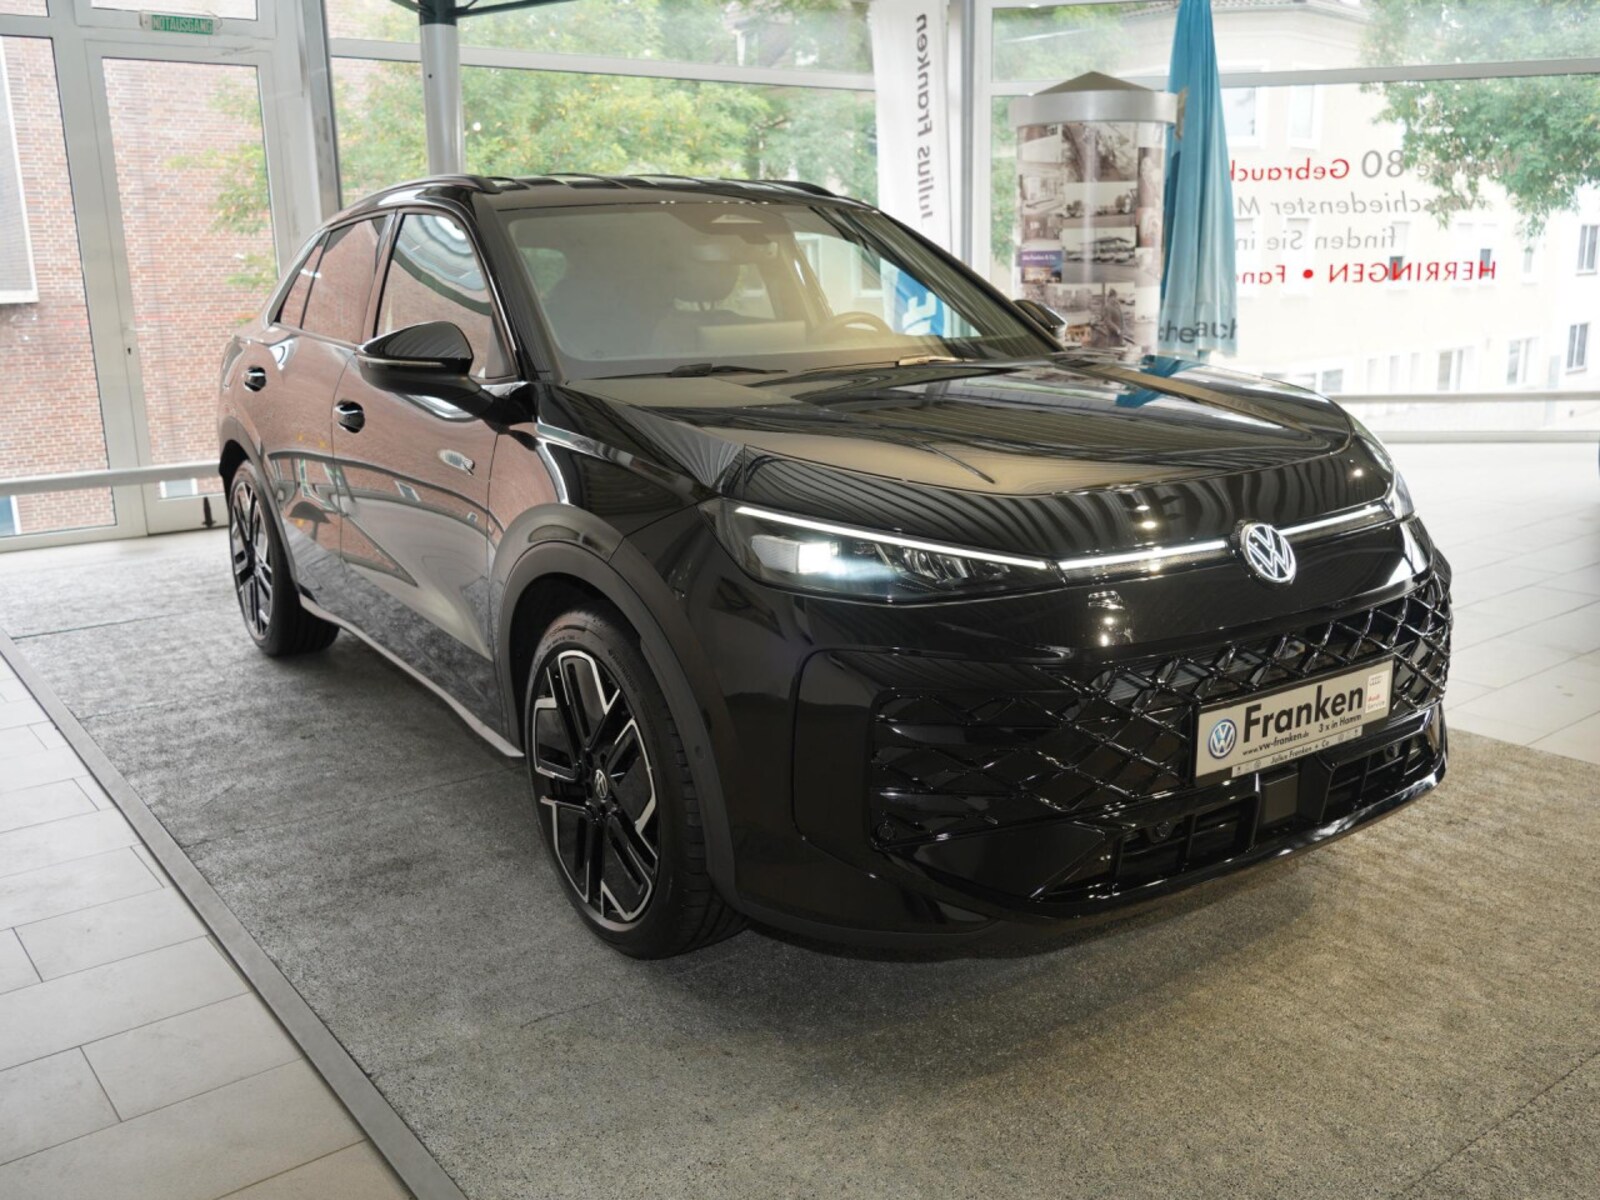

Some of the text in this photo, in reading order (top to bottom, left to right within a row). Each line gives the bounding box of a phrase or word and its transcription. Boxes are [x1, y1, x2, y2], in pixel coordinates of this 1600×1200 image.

[152, 15, 213, 34] NOTAUSGANG
[1243, 685, 1363, 743] Franken
[1242, 730, 1309, 756] www.vw-franken.de
[1318, 723, 1324, 733] 3
[1331, 720, 1338, 730] in
[1339, 713, 1362, 727] Hamm
[1288, 745, 1313, 762] Franken
